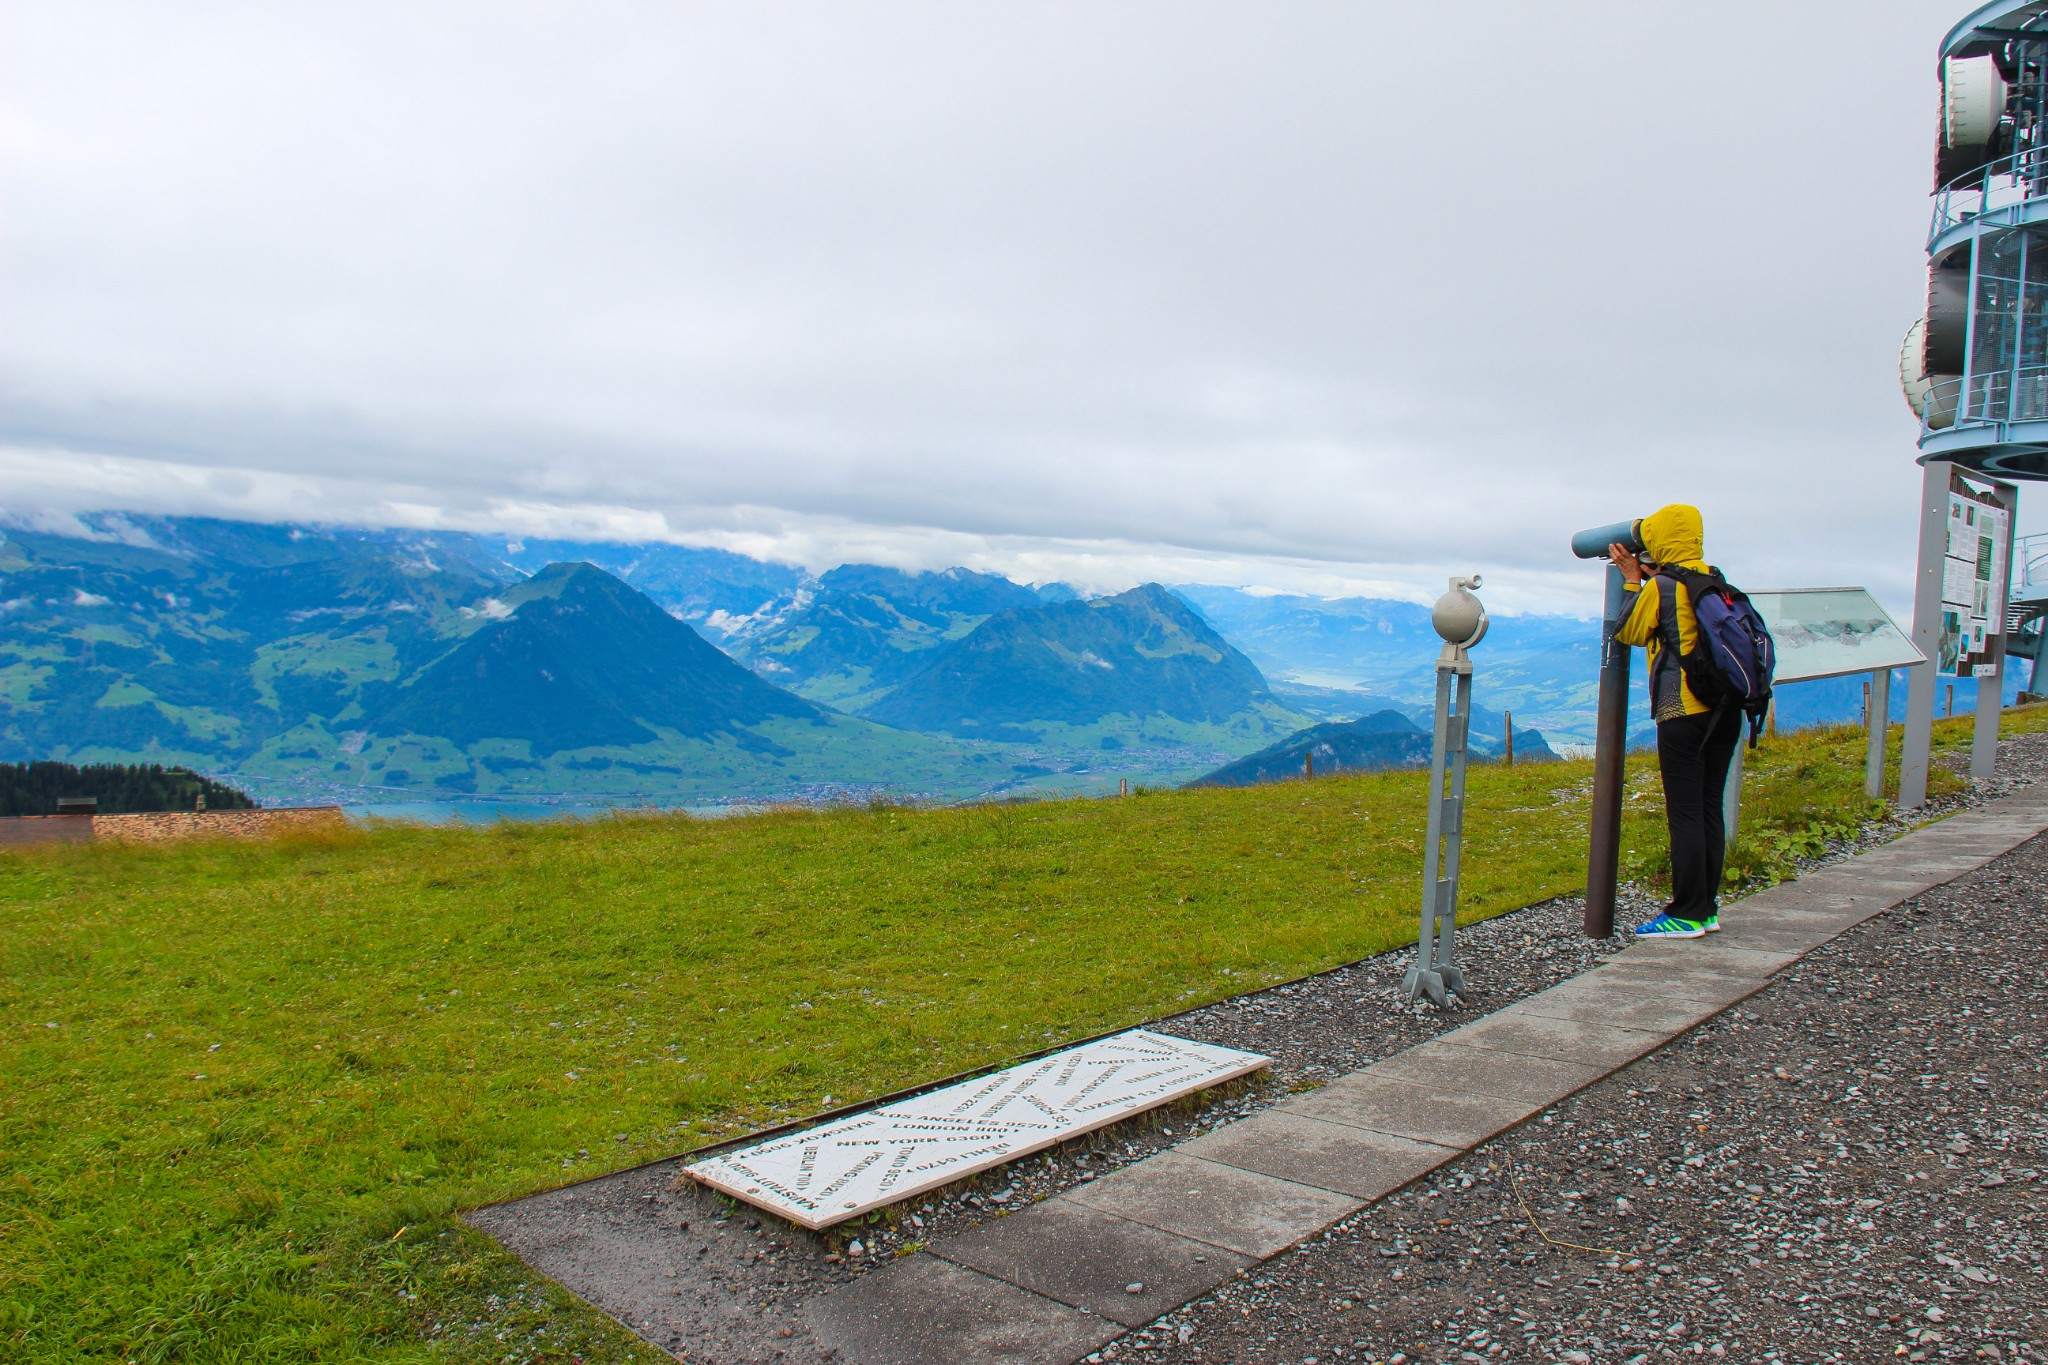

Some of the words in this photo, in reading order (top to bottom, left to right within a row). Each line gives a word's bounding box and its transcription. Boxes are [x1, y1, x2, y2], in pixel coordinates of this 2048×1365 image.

[1206, 1056, 1254, 1073] SYDNEY
[1055, 1068, 1075, 1086] DAKAR
[1081, 1065, 1121, 1094] WARSCHAU
[1125, 1071, 1164, 1083] BERN
[974, 1075, 1011, 1099] MOSKAU
[980, 1094, 1017, 1117] BUENOS
[1011, 1077, 1037, 1094] AIRES
[1074, 1095, 1136, 1112] LUZERN
[917, 1116, 999, 1125] ANGELES
[795, 1121, 875, 1144] BANGKOK
[800, 1146, 818, 1171] BERLIN
[894, 1146, 915, 1168] TOKIO
[960, 1143, 1011, 1158] DEHLI
[843, 1151, 885, 1178] PEKING
[916, 1157, 957, 1170] 6170
[796, 1172, 813, 1186] 700
[819, 1178, 850, 1197] 8020
[753, 1178, 819, 1210] KAPSTADT
